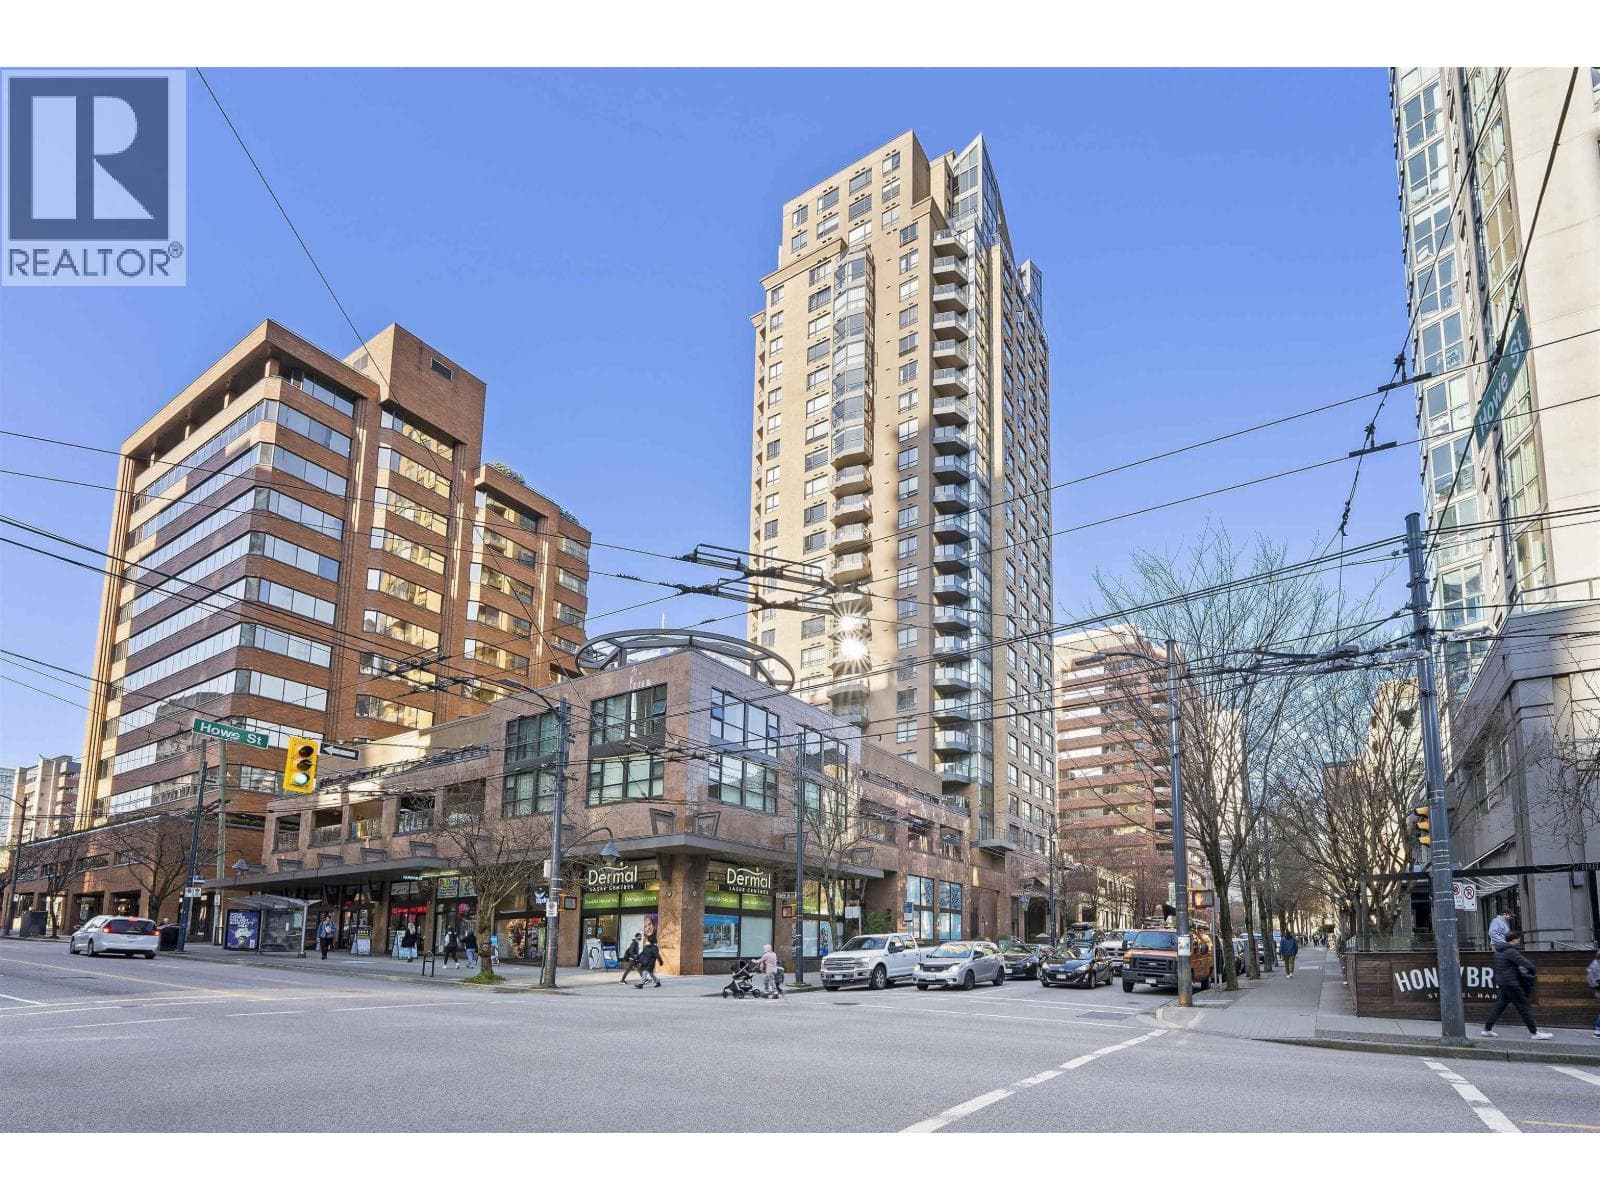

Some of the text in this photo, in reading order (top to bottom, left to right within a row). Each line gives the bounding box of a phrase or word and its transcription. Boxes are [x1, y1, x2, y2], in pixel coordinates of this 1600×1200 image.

[1478, 329, 1525, 436] Howe St
[200, 722, 263, 746] Howe St
[588, 865, 638, 885] Dermal
[726, 867, 771, 889] Dermal
